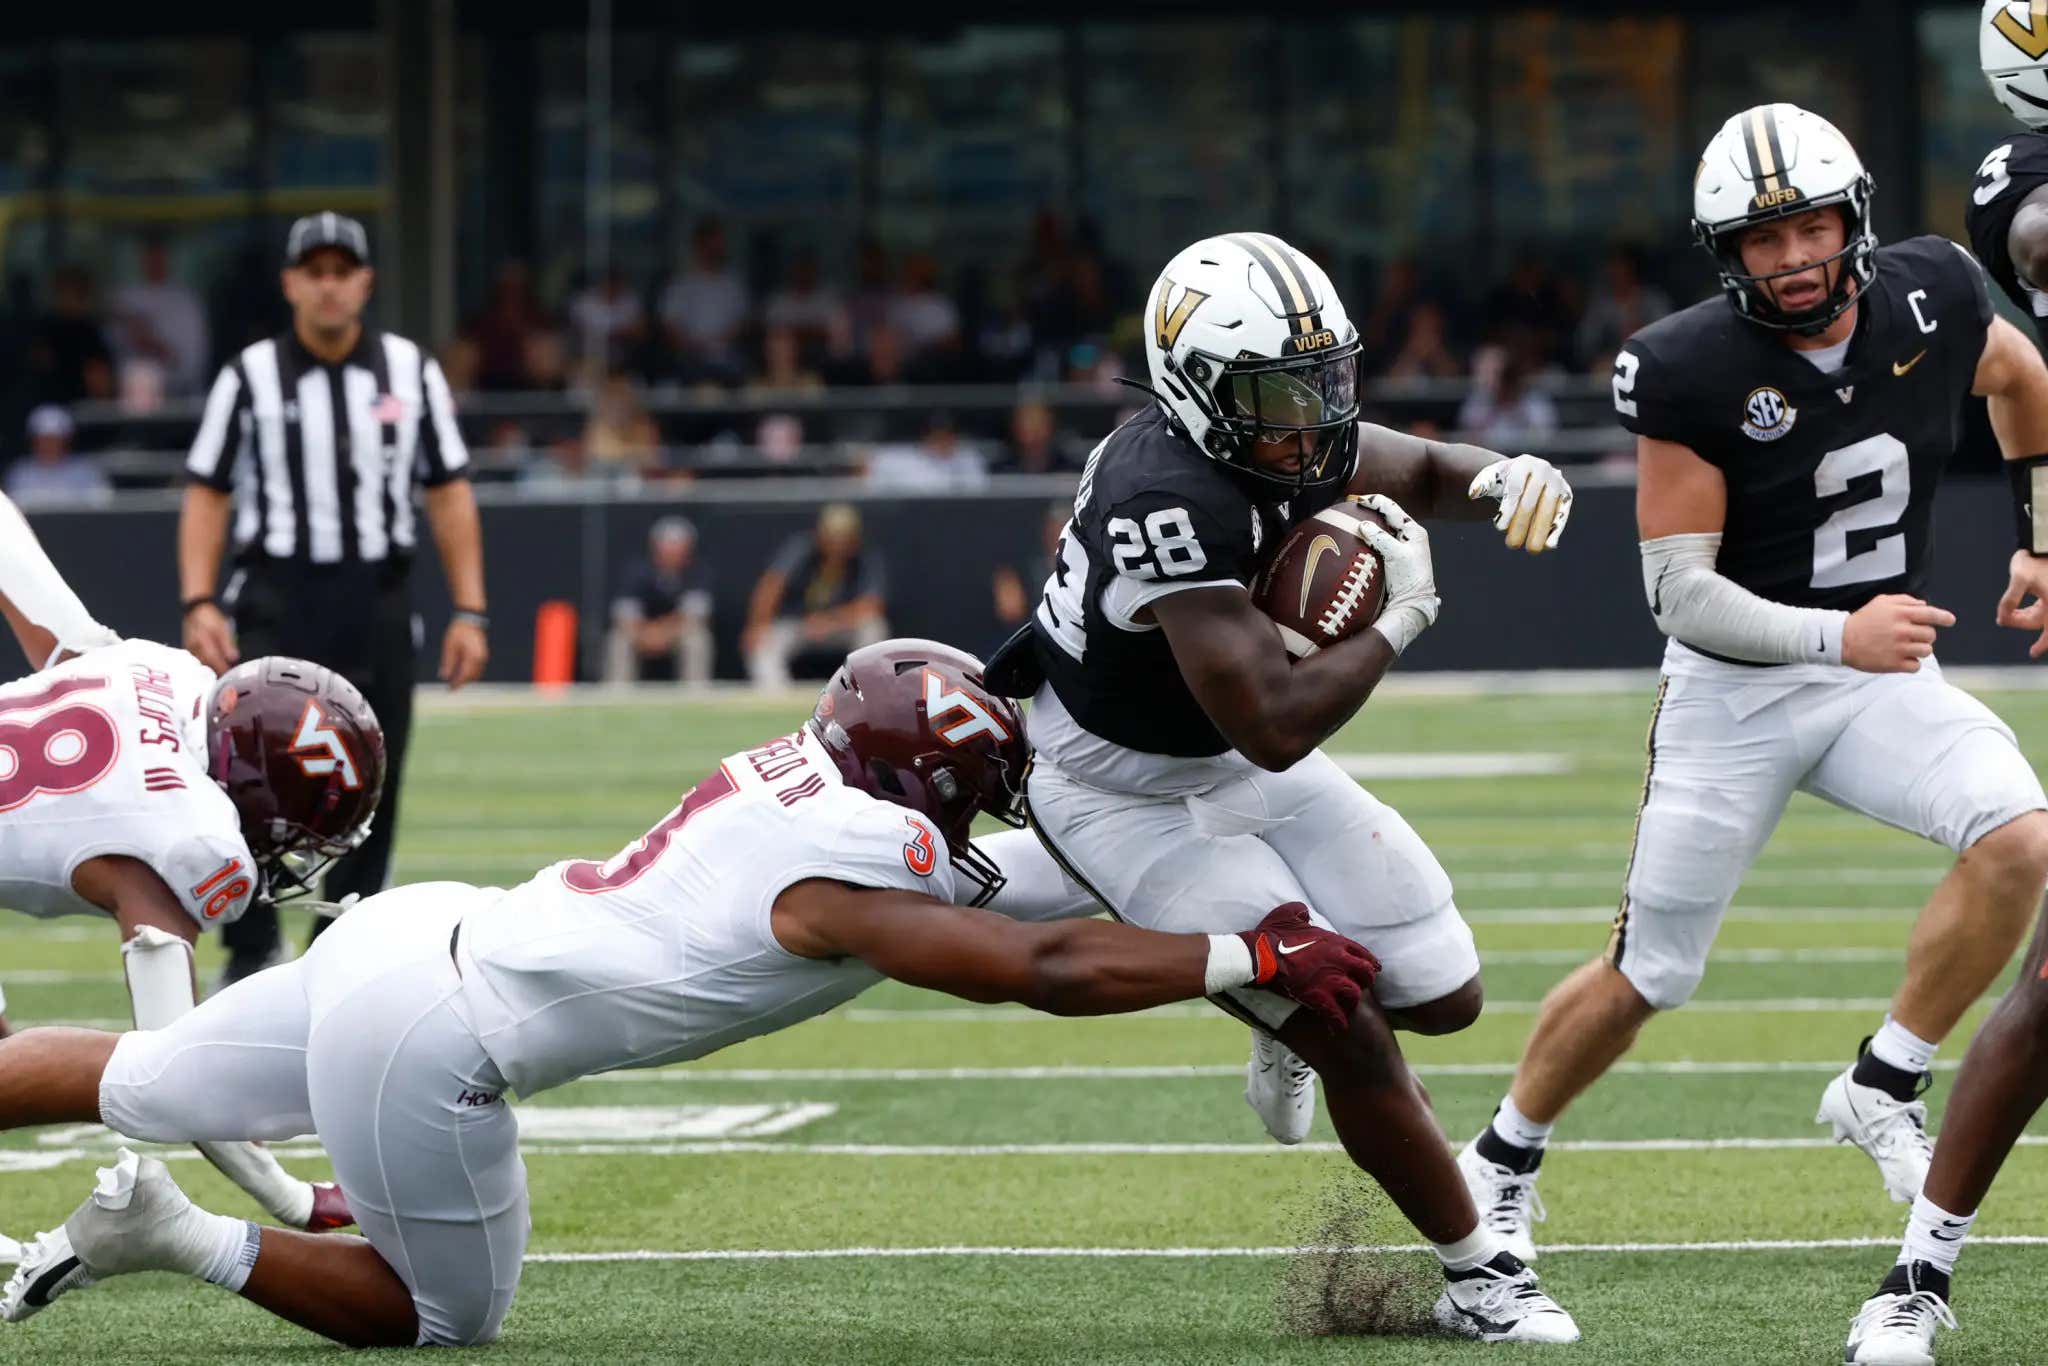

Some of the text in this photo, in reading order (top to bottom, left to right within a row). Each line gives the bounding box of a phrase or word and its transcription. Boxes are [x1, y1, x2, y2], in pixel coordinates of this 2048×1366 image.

[1754, 187, 1797, 209] VUFB
[1973, 144, 2012, 206] 3
[1155, 276, 1211, 352] V
[1294, 331, 1333, 352] VUFB
[1907, 289, 1937, 334] C
[1612, 350, 1639, 418] 2
[1746, 389, 1785, 428] SEC
[1835, 385, 1854, 404] V
[1809, 432, 1911, 588] 2
[1107, 507, 1208, 576] 28
[0, 674, 121, 813] 18
[144, 767, 188, 791] III
[776, 772, 826, 807] III
[903, 815, 937, 877] 3
[190, 856, 253, 921] 18
